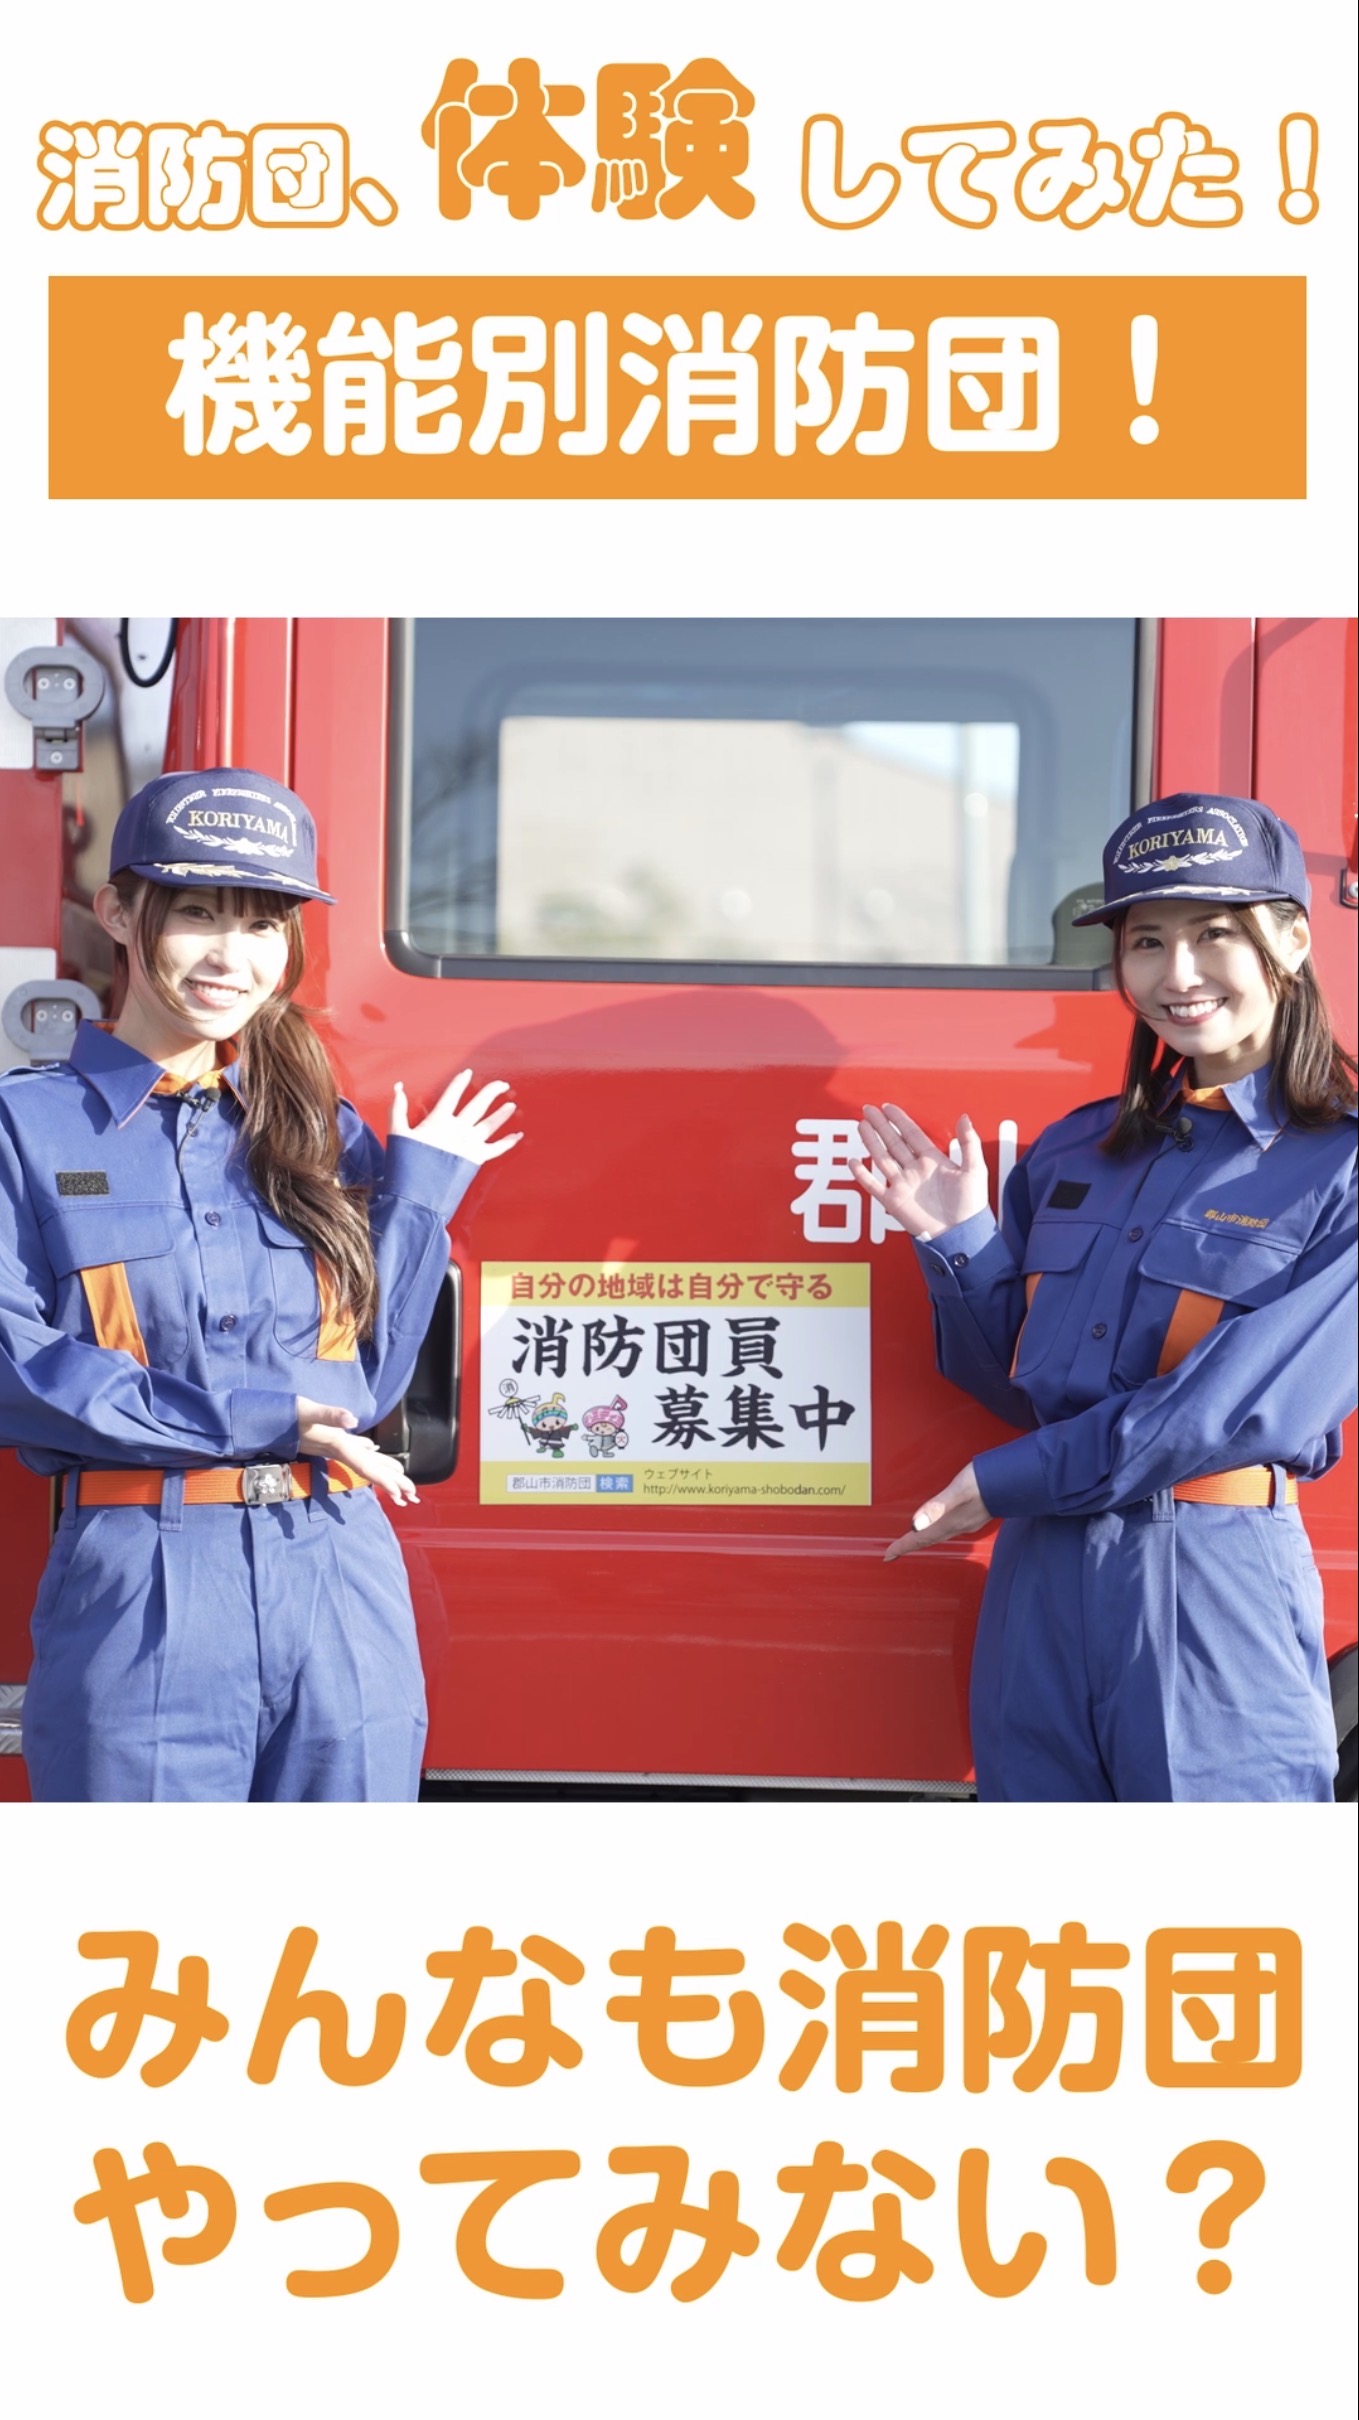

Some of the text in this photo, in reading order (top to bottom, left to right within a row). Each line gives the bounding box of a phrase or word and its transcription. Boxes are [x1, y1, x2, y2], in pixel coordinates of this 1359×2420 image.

[188, 810, 288, 844] KORIYAMA
[1128, 828, 1229, 860] KORIYAMA
[511, 1272, 833, 1300] 自分の地域は自分で守る
[511, 1314, 783, 1379] 消防団員
[651, 1383, 856, 1452] 募集中
[512, 1476, 629, 1490] 郡山市消防団 検索
[644, 1468, 713, 1480] ウェブサイト
[643, 1484, 846, 1497] http://www.koriyama-shobodan.com/
